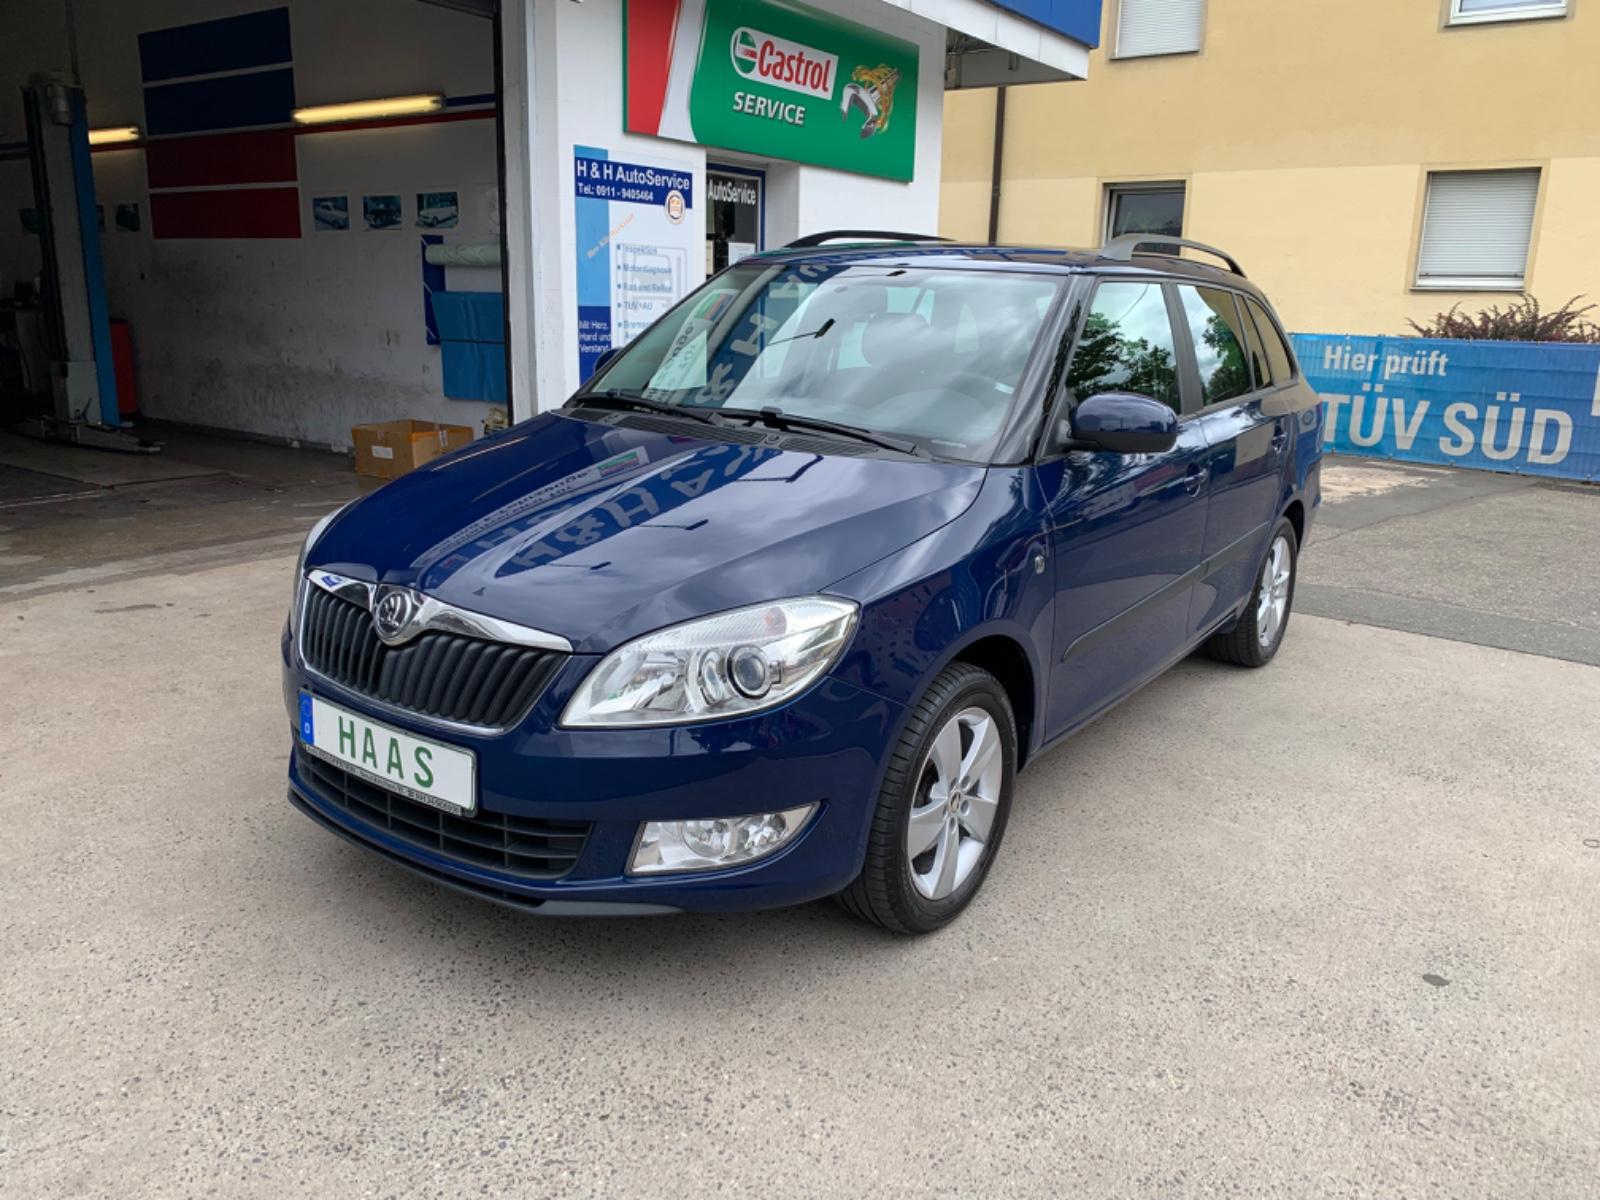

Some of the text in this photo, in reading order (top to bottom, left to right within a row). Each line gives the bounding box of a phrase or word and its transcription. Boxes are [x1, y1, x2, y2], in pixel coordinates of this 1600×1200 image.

[757, 40, 831, 92] Castrol
[732, 91, 806, 126] SERVICE
[577, 160, 690, 190] H & H AutoService
[707, 179, 757, 205] AutoService
[1323, 345, 1448, 380] Hier prüft
[1318, 382, 1573, 465] TÜV SÜD
[338, 715, 434, 788] HAAS
